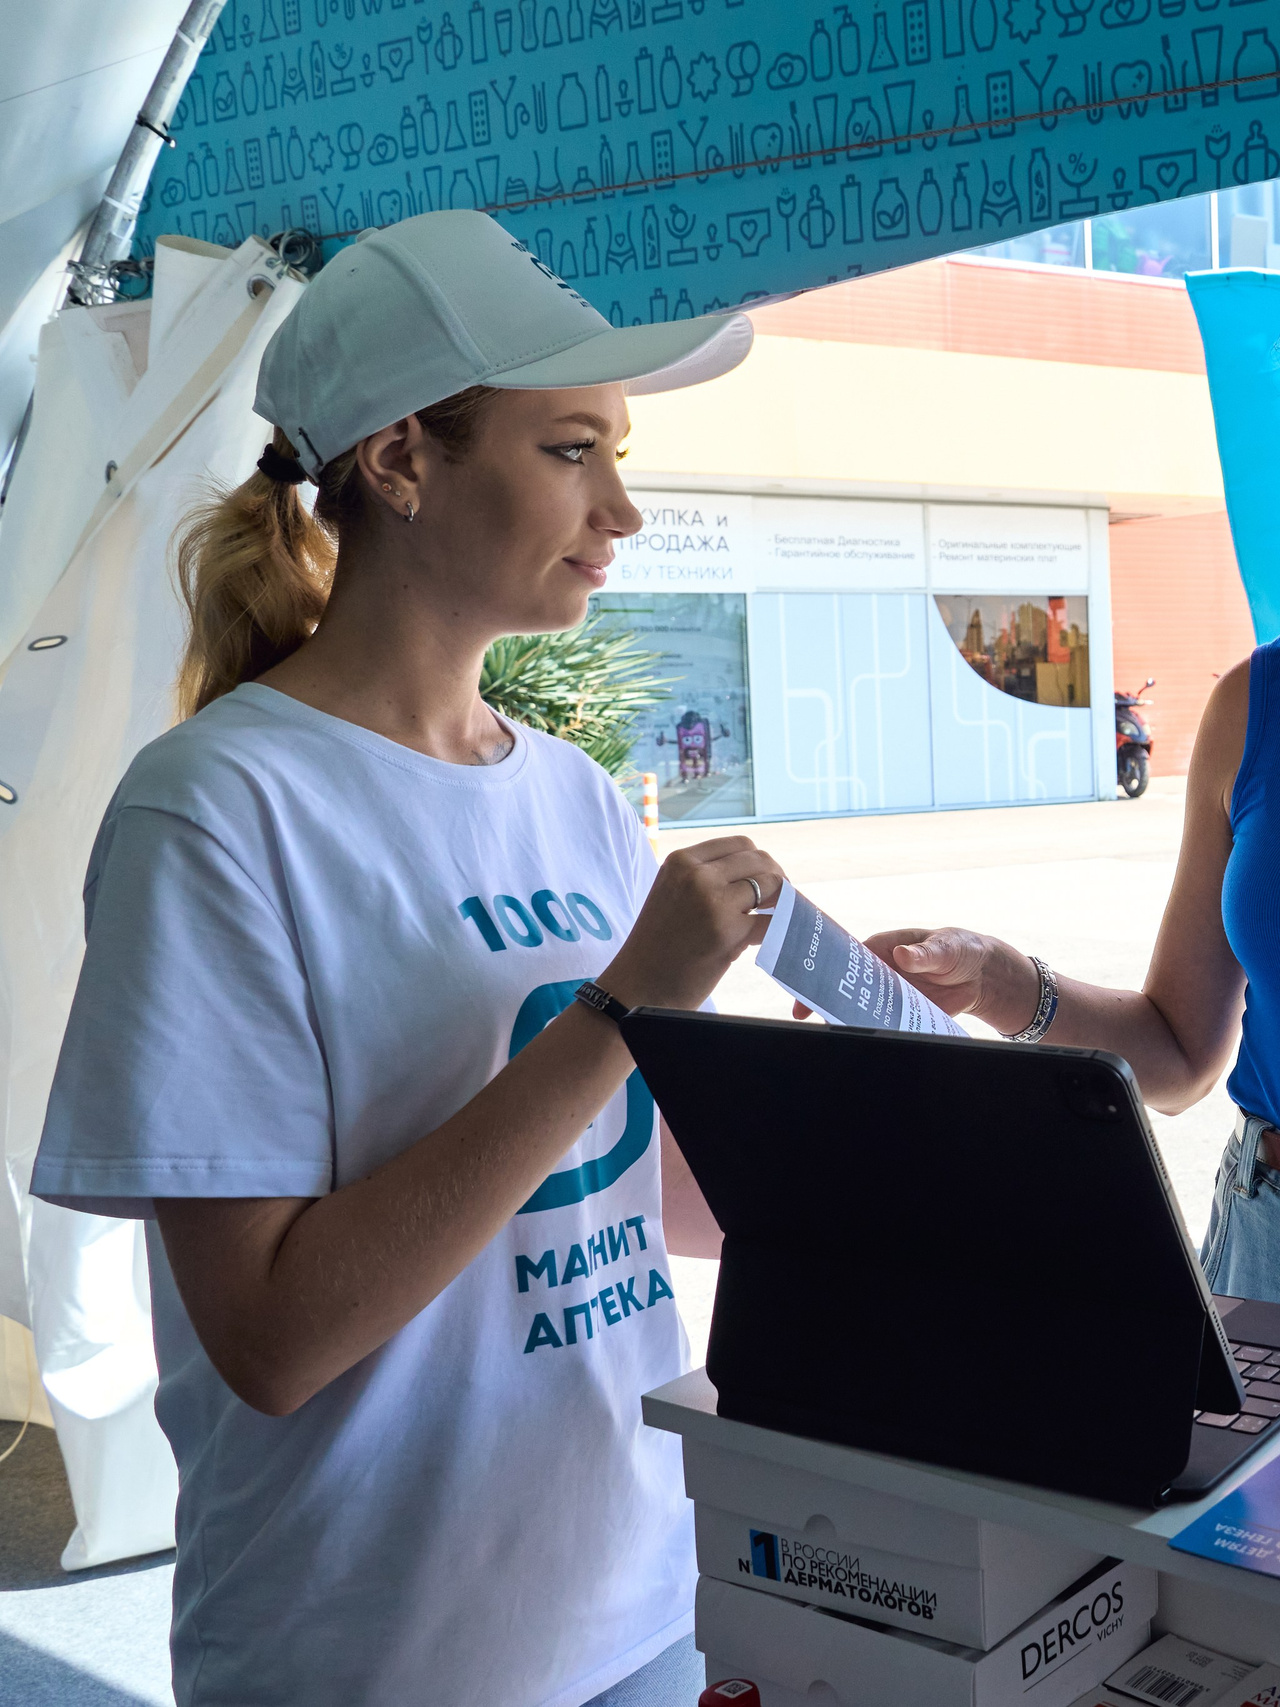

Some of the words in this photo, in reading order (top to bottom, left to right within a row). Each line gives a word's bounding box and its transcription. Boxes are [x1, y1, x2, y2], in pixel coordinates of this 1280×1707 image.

[620, 533, 730, 553] ПРОДАЖА
[774, 534, 835, 547] Бесплатная
[837, 535, 901, 547] Диагностика
[775, 547, 840, 559] Гарантийное
[843, 549, 915, 561] обслуживание
[939, 551, 973, 561] Ремонт
[622, 564, 652, 579] Б/У
[658, 565, 733, 580] ТЕХНИКИ
[457, 888, 612, 952] 1000
[857, 986, 871, 1011] на
[884, 1014, 891, 1027] по
[515, 1214, 648, 1293] МАГНИТ
[523, 1267, 675, 1355] АПТЕКА
[1214, 1522, 1273, 1547] ГЕНЕЗА
[781, 1538, 790, 1554] В
[793, 1542, 861, 1571] РОССИИ
[1213, 1538, 1269, 1560] ДЕТЯМ
[782, 1553, 806, 1571] ПО
[810, 1561, 937, 1606] РЕКОМЕНДАЦИИ
[1021, 1581, 1123, 1680] DERCOS
[1097, 1614, 1124, 1641] VICHY
